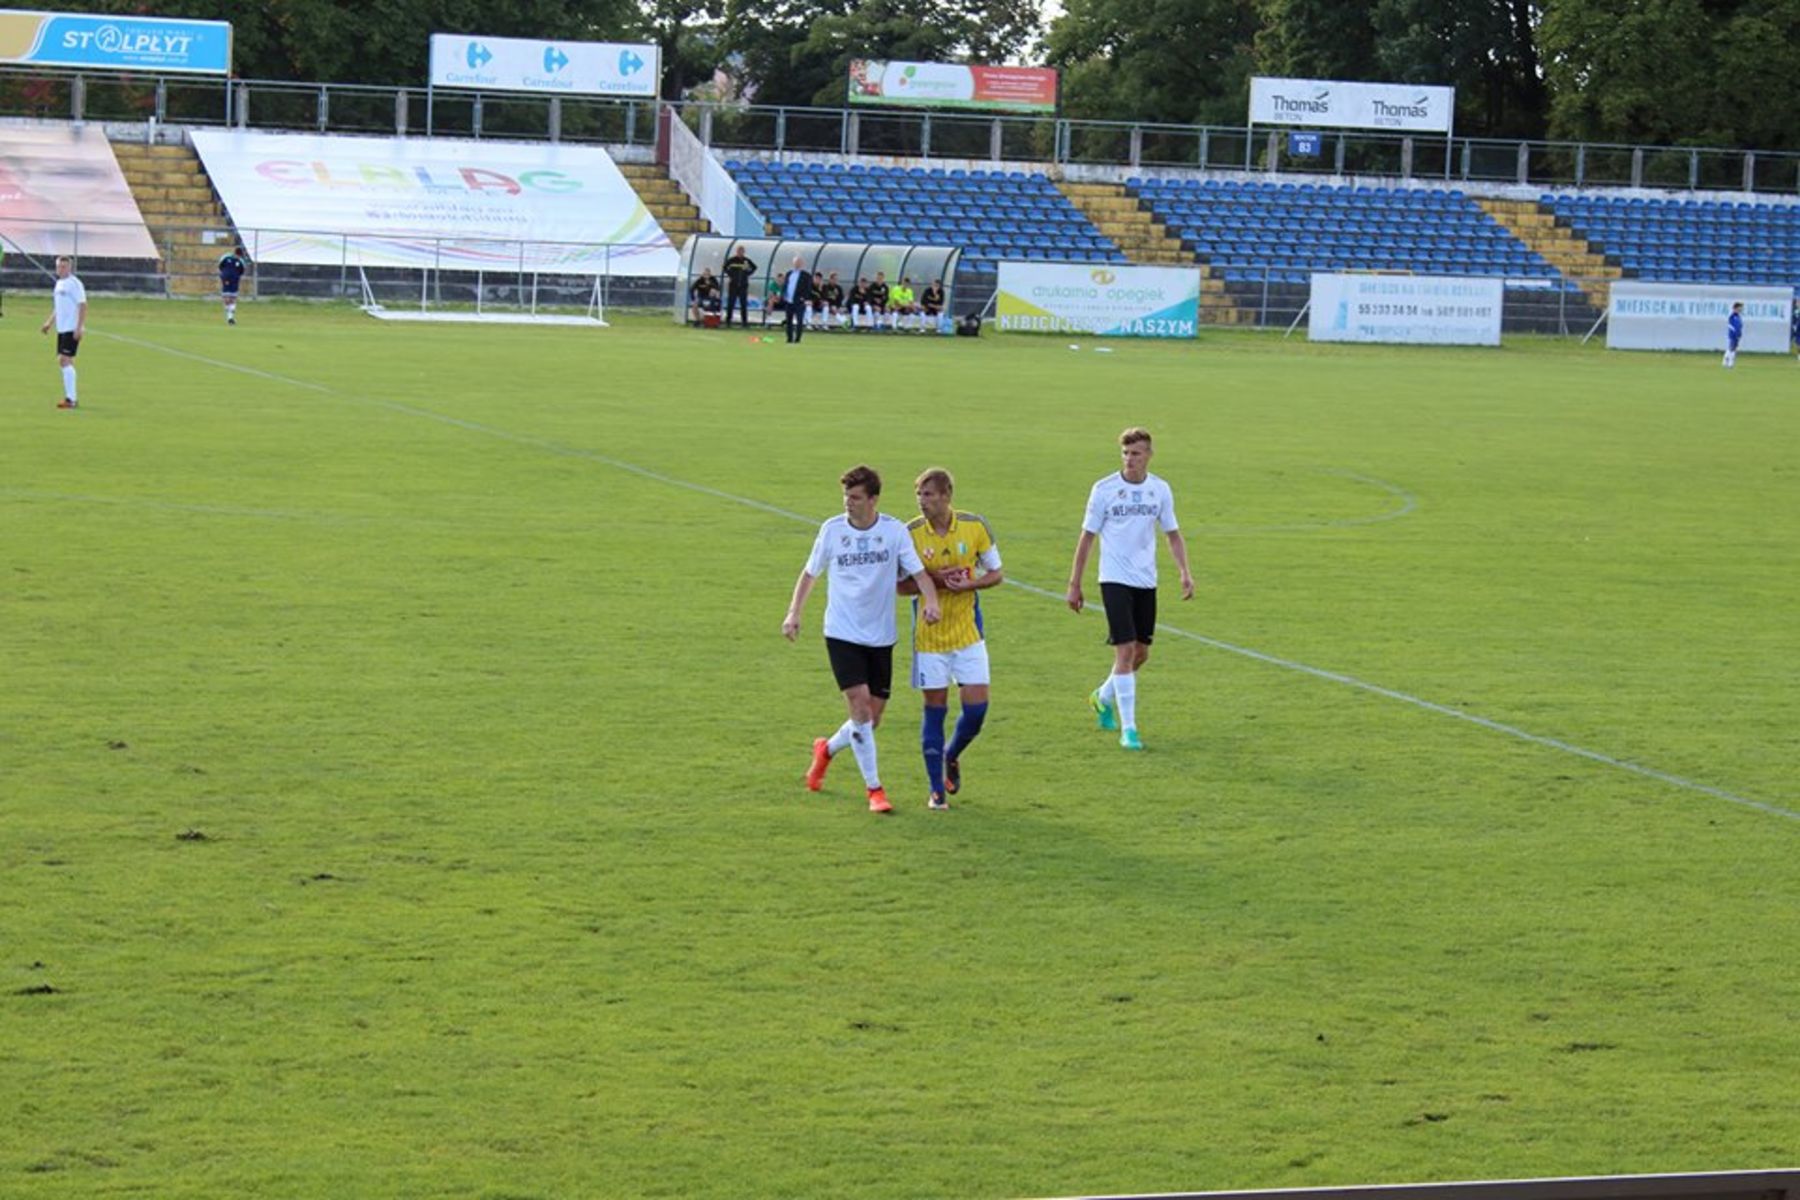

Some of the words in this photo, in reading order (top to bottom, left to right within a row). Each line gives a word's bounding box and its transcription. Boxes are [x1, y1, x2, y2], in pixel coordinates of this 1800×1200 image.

[446, 72, 497, 85] Carrefour
[523, 76, 573, 88] Carrefour
[600, 79, 649, 91] Carrefour
[1031, 286, 1098, 299] drukarnia
[1120, 318, 1194, 335] NASZYM
[836, 549, 890, 567] WEJHEROWO
